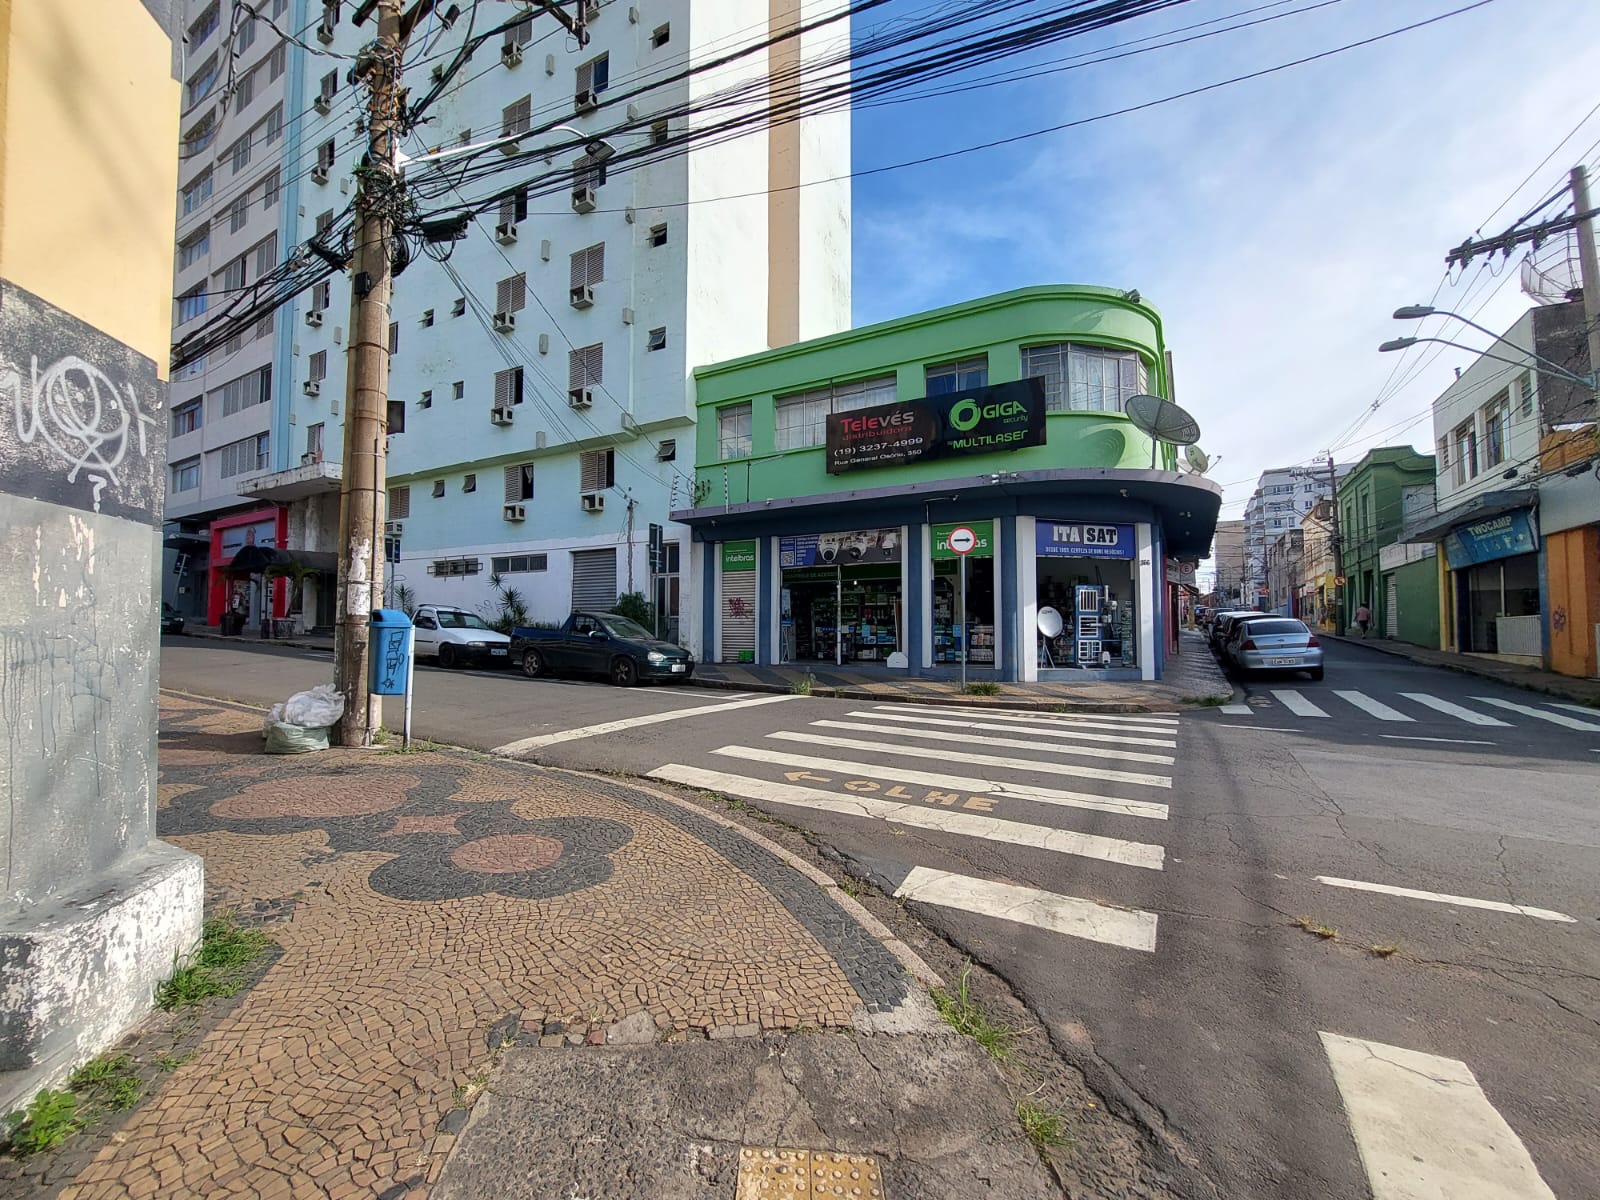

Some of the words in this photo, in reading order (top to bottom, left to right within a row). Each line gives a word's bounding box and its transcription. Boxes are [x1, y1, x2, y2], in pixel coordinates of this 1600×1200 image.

[983, 400, 1028, 419] GIGA
[840, 410, 914, 433] Televés
[834, 447, 856, 457] (19)
[859, 437, 923, 452] 3237-4999
[1053, 525, 1081, 543] ITA
[1086, 527, 1116, 543] SAT
[1467, 516, 1512, 536] TWOCAMP
[725, 554, 754, 562] intelbras
[843, 780, 1000, 812] OLHE
